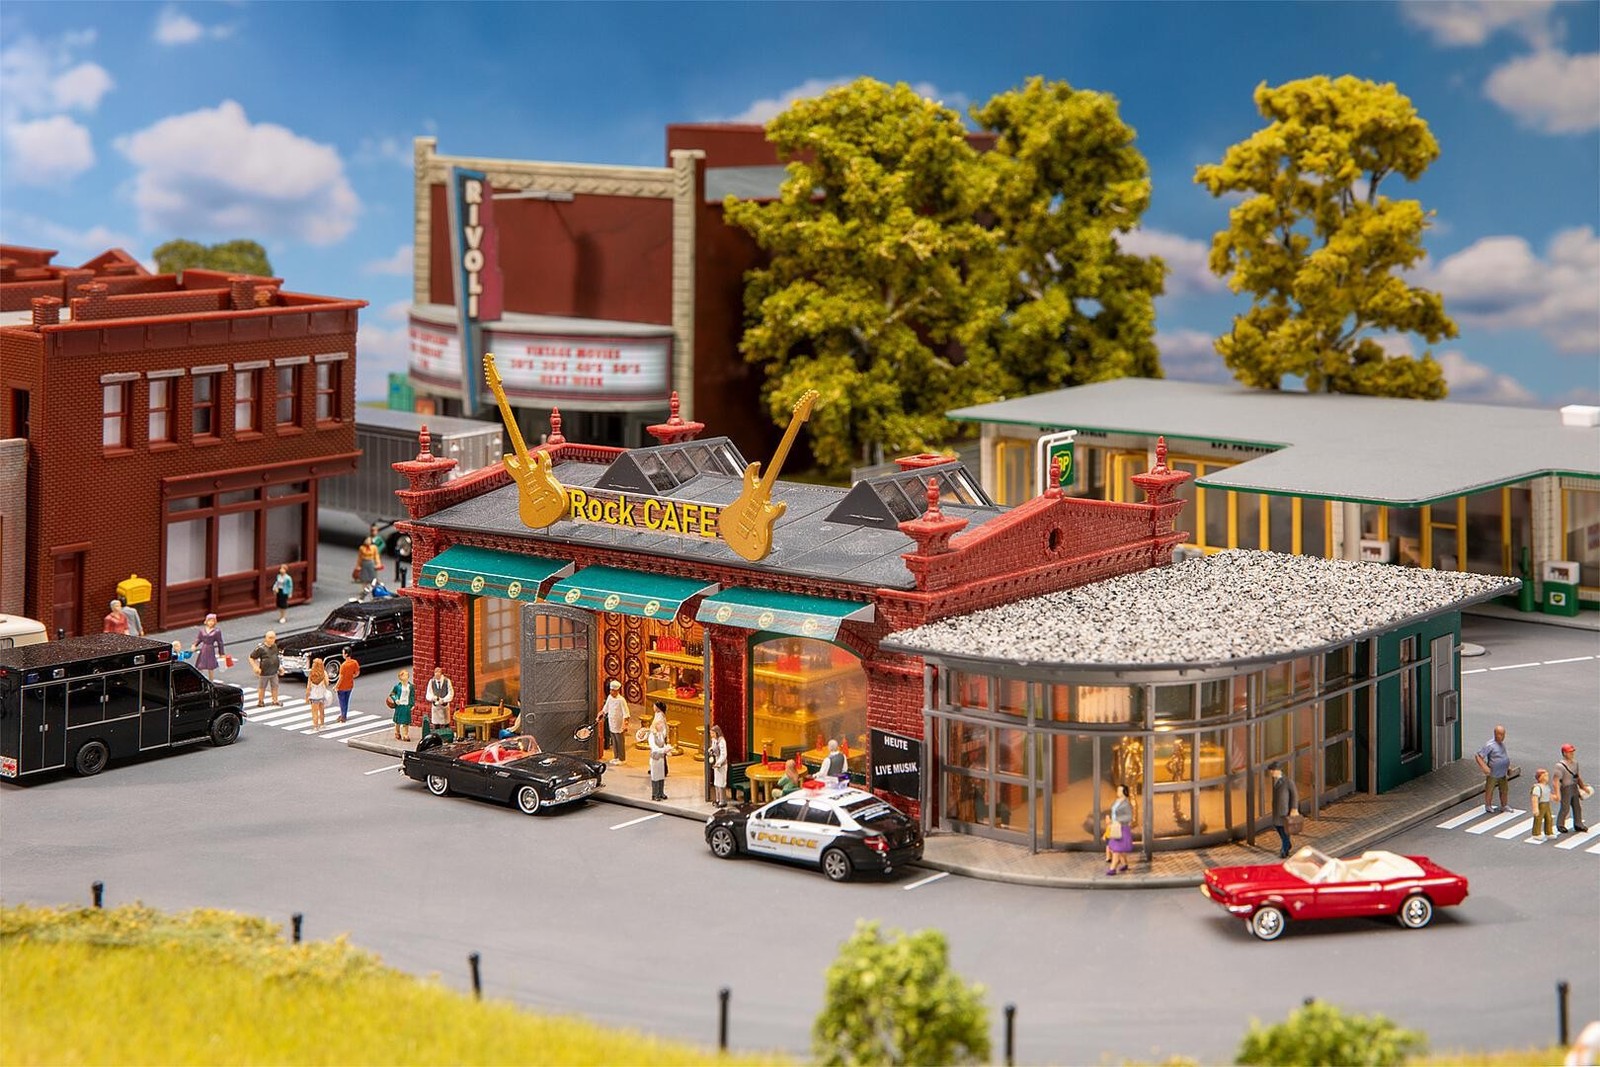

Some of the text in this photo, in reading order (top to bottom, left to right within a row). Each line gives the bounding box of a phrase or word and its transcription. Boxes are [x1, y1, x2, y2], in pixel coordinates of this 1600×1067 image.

[463, 180, 484, 318] RIVOLI
[576, 347, 621, 359] MOVIES
[644, 499, 718, 538] CAFE
[884, 735, 909, 750] HEUTE
[875, 762, 918, 776] LIVE MUSIK
[758, 832, 818, 848] POLICE
